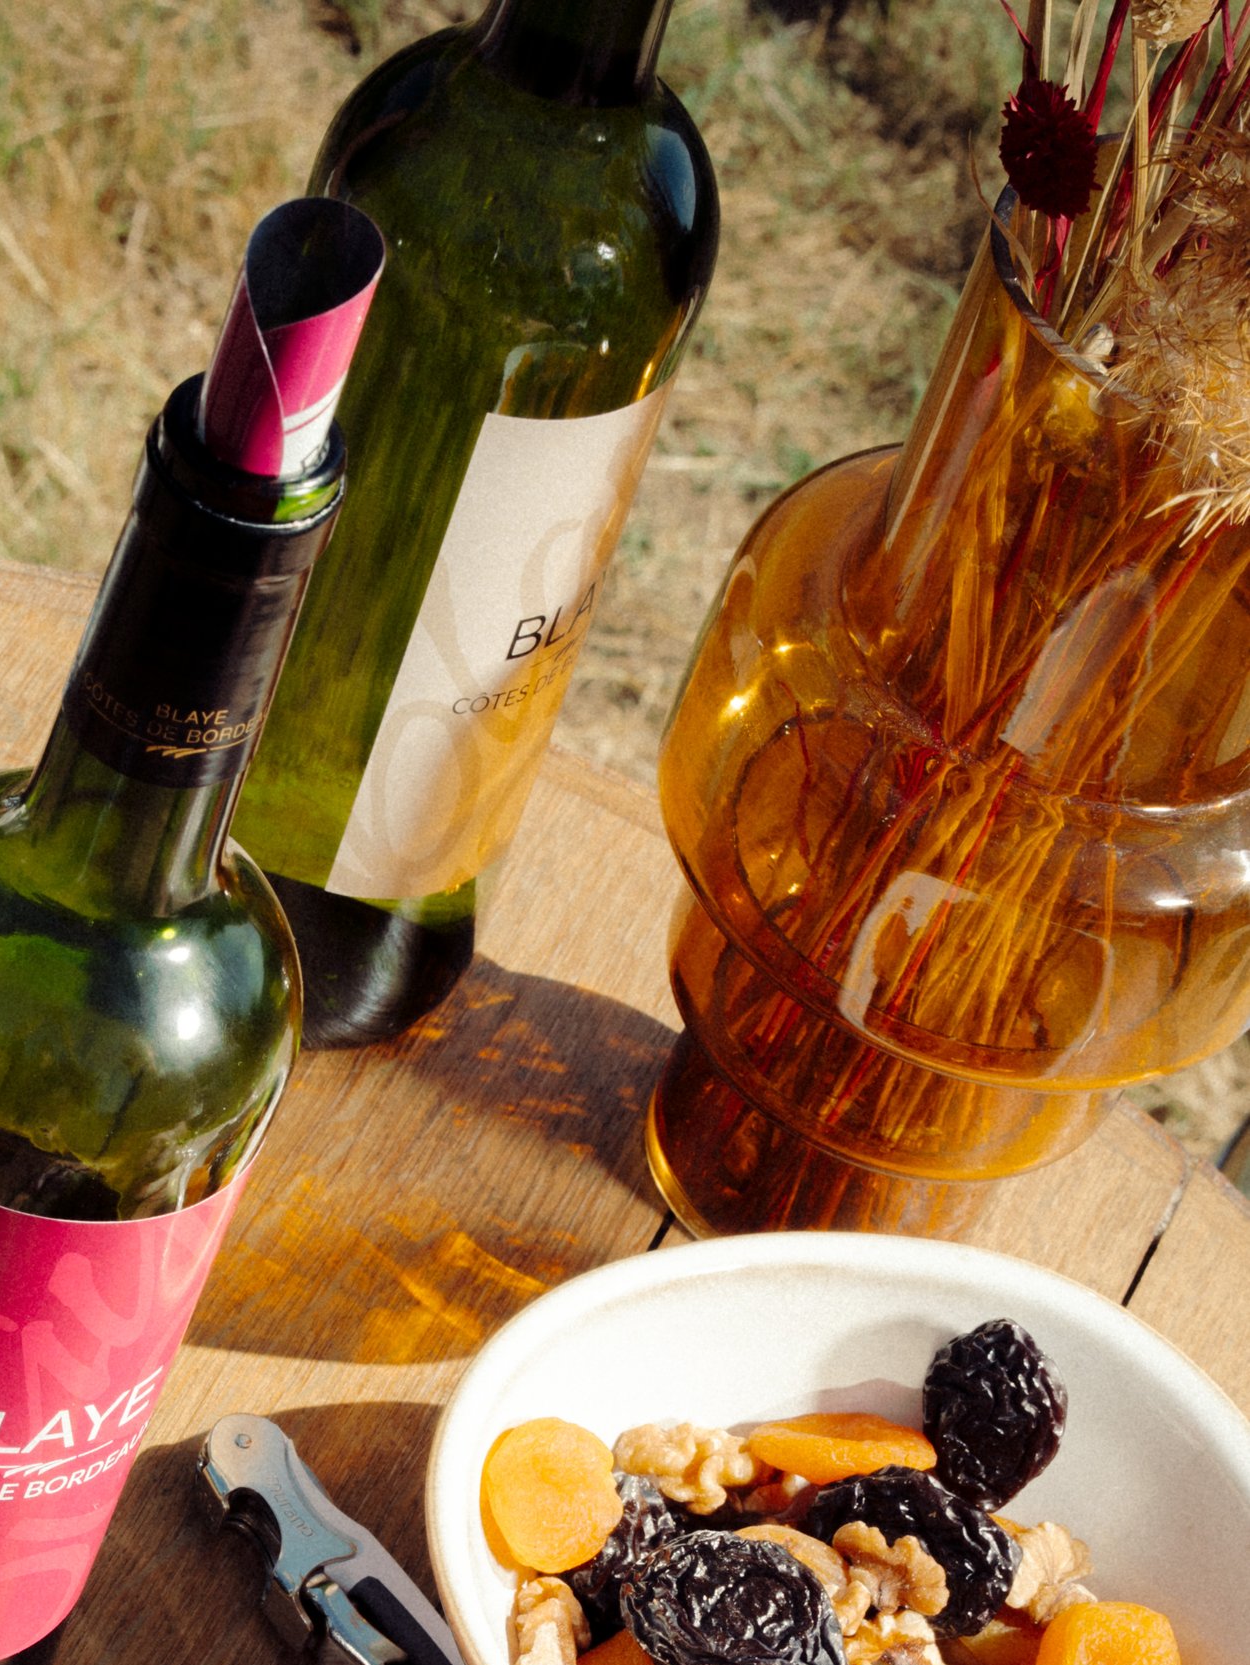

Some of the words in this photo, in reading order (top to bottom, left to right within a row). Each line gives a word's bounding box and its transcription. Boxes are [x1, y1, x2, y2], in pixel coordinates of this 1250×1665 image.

[505, 582, 596, 661] BLA
[155, 703, 229, 725] BLAYE
[452, 684, 529, 715] CÔTES
[186, 707, 265, 744] BORDE
